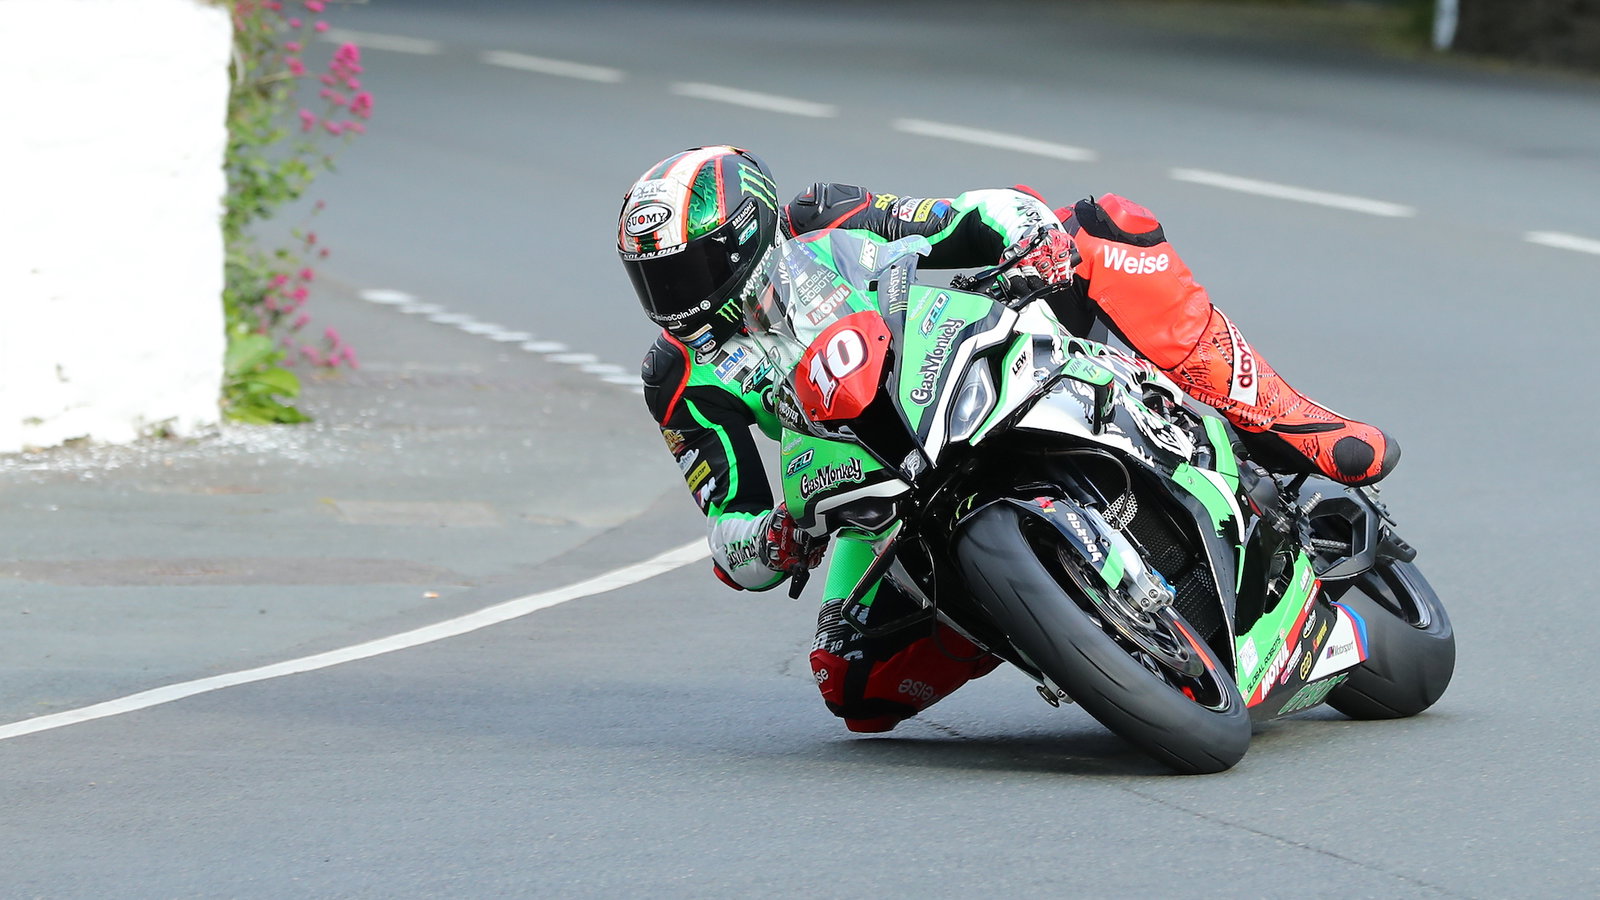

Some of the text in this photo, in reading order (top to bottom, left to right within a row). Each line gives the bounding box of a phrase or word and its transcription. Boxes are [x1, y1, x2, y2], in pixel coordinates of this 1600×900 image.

[627, 212, 666, 228] SUOMY
[732, 202, 754, 227] BREMONT
[740, 244, 775, 301] MONSTER
[1103, 244, 1169, 275] Weise
[798, 267, 828, 297] GLOBAL
[802, 271, 837, 304] ROBOTS
[811, 287, 849, 324] MOTUL
[714, 347, 745, 379] LEW
[809, 329, 866, 409] 10
[910, 318, 966, 406] GasMonkey
[1012, 351, 1027, 376] LEW
[801, 457, 863, 500] GasMonkey
[1066, 513, 1102, 562] DUNLOP
[1262, 640, 1290, 700] MOTUL
[898, 678, 938, 699] eise
